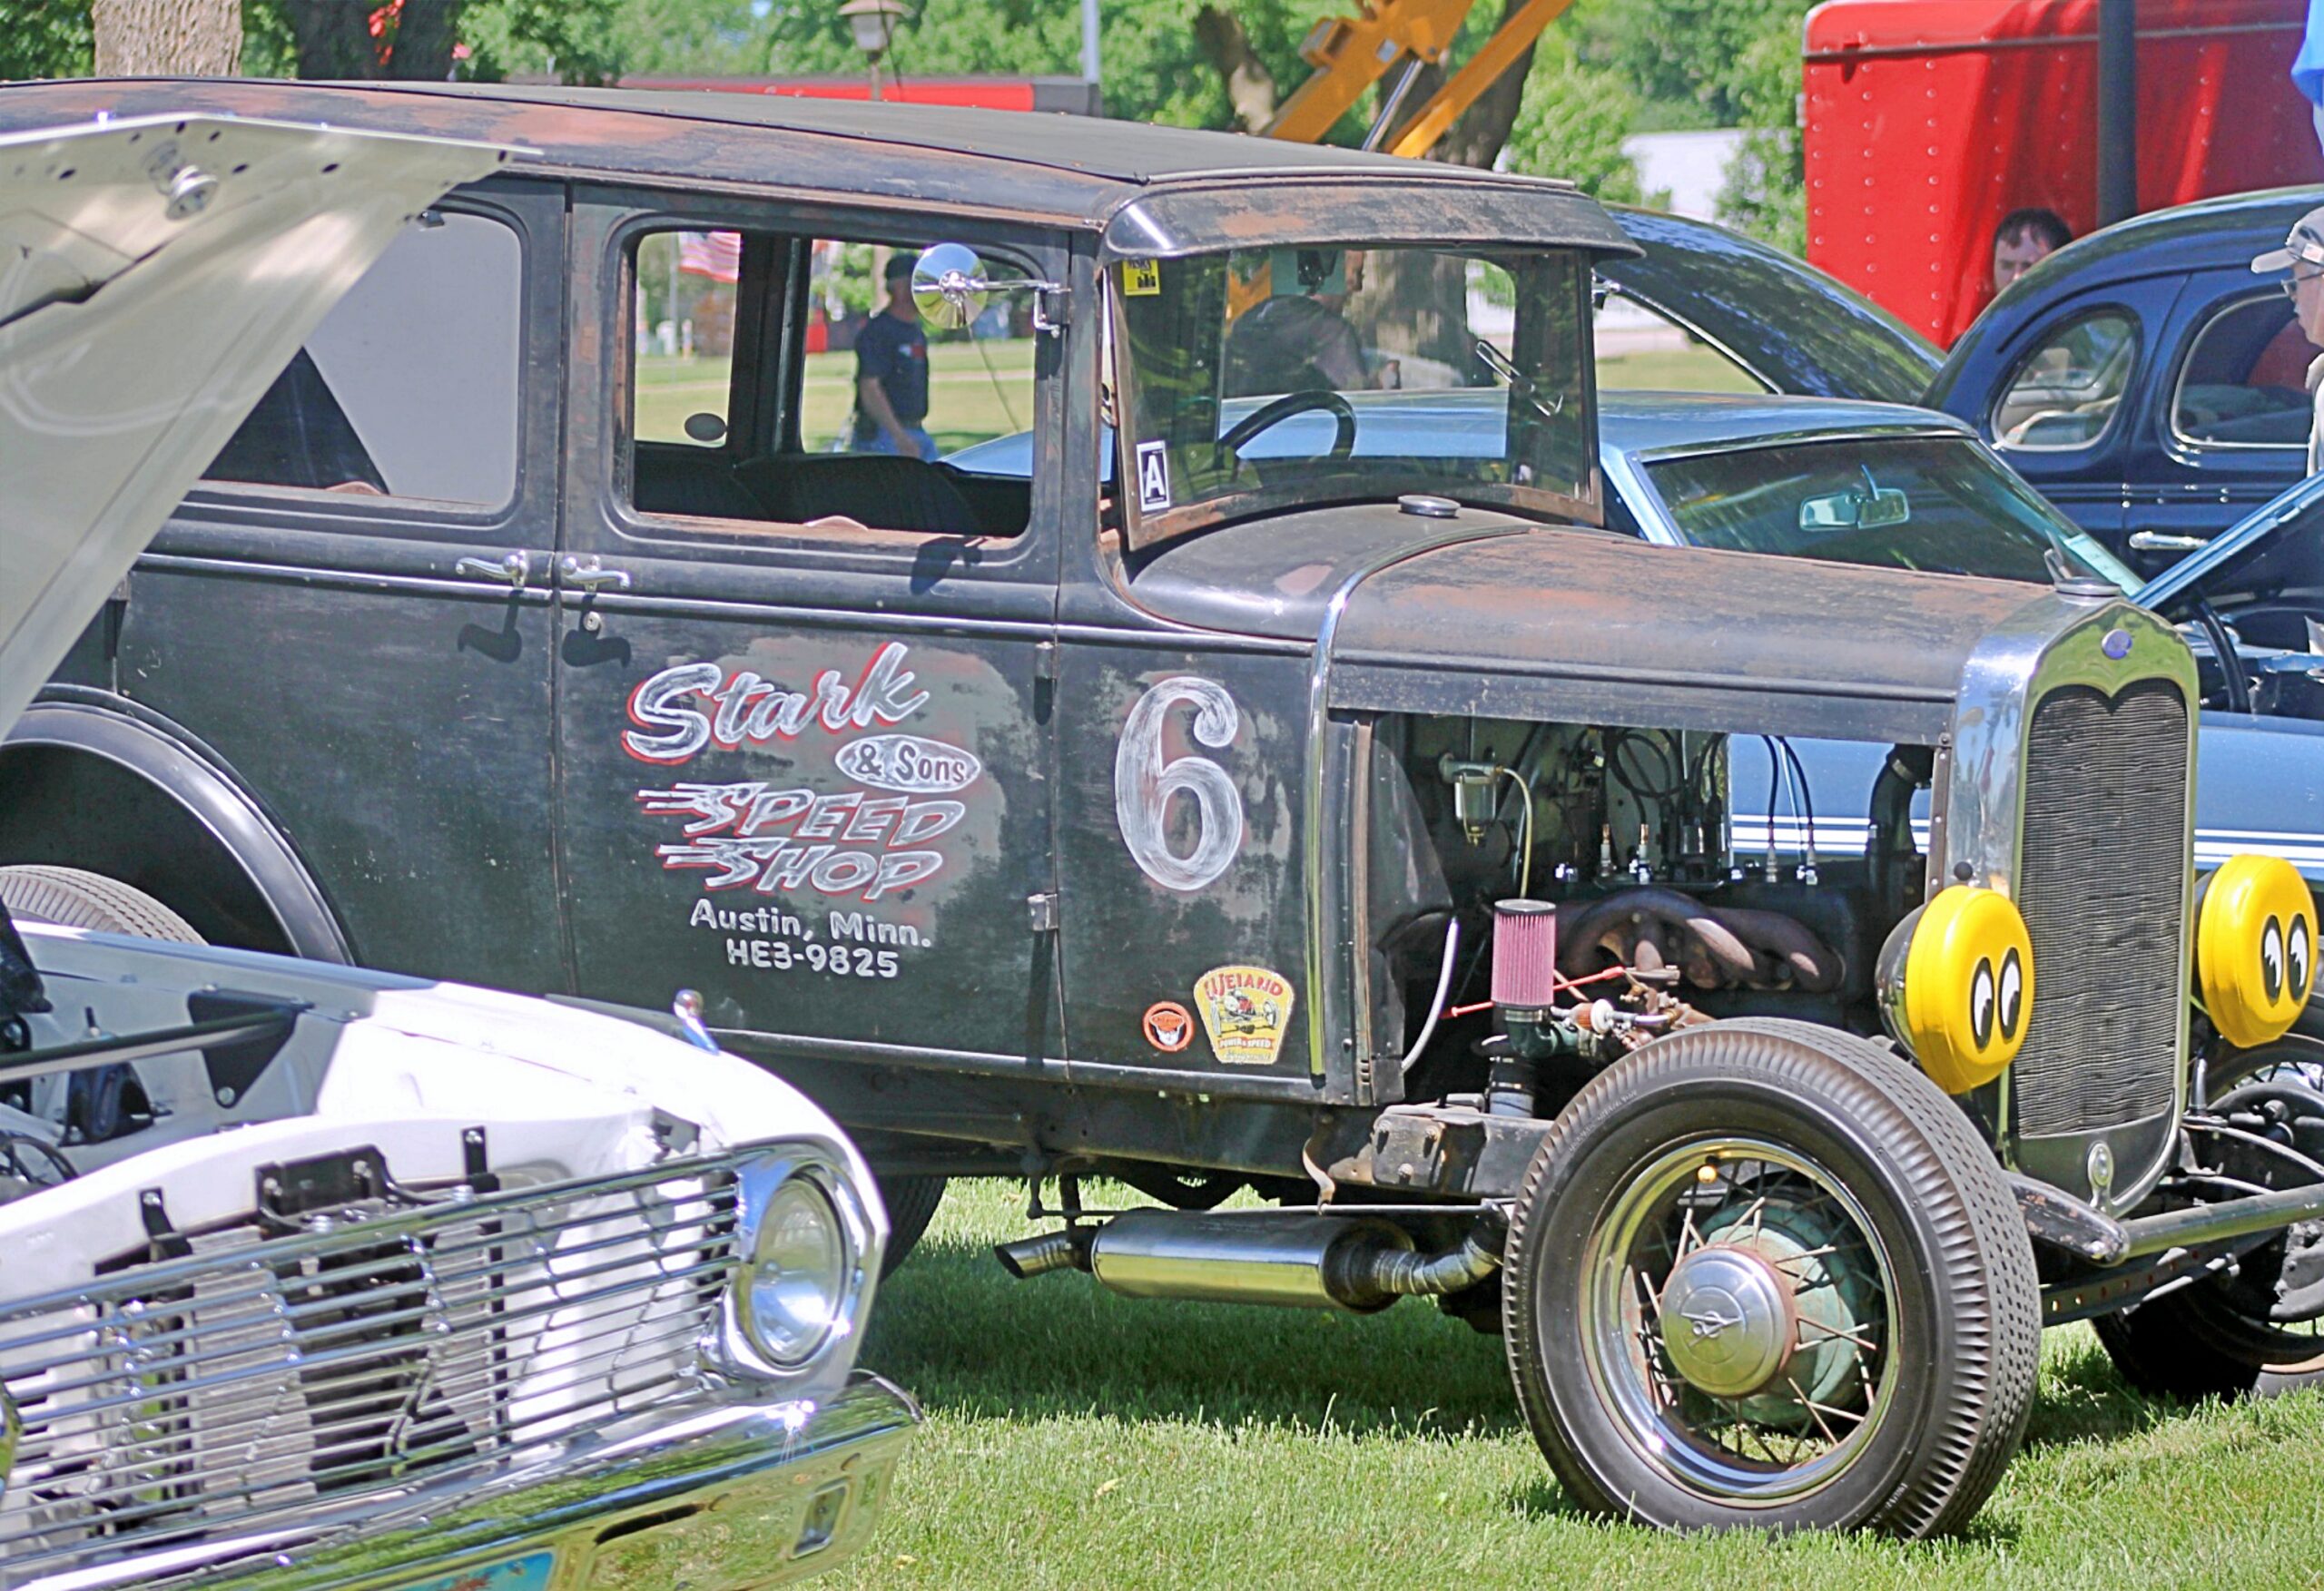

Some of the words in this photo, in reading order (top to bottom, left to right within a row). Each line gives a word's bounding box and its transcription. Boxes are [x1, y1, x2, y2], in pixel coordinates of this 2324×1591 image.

[1145, 454, 1166, 498] A
[623, 641, 930, 765] Stark
[856, 743, 881, 776] &
[895, 744, 966, 784] Sons
[1115, 676, 1242, 891] 6
[636, 781, 966, 848] SPEED
[655, 836, 944, 901] SHOP
[689, 898, 813, 942] Austin,
[829, 910, 931, 948] Minn.
[726, 938, 898, 978] HE3-9825
[1247, 1037, 1271, 1048] SPEED
